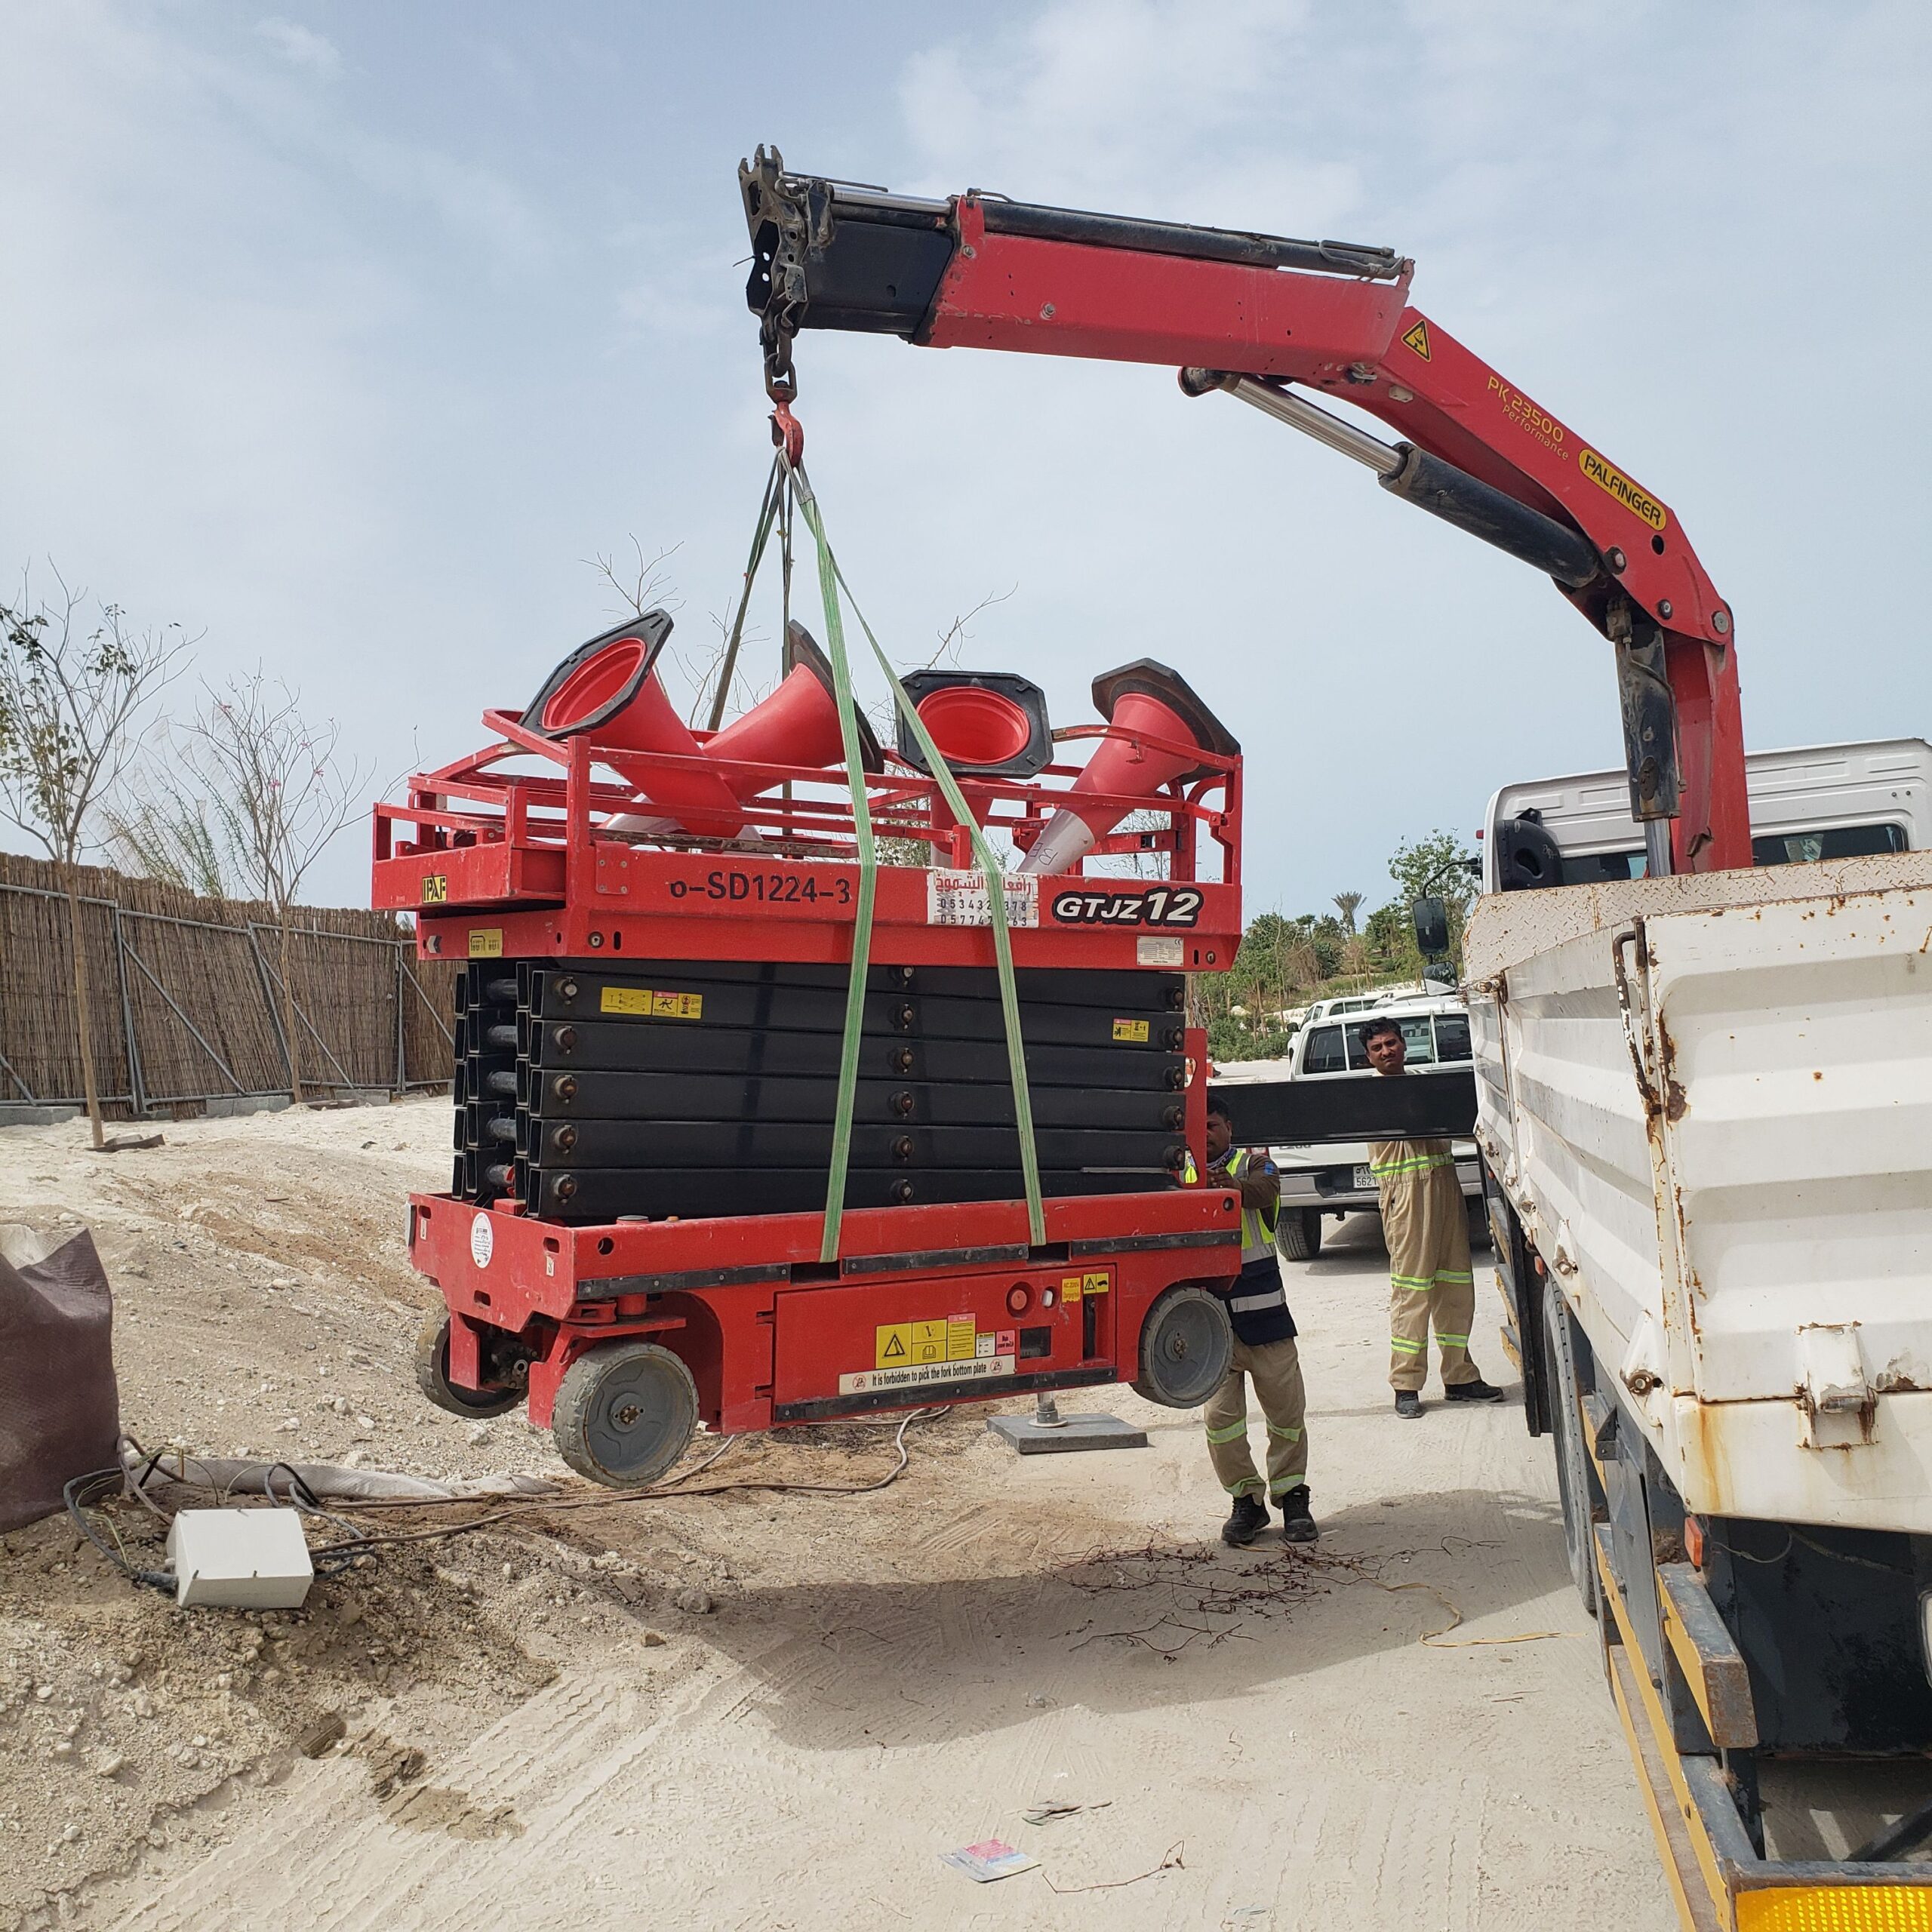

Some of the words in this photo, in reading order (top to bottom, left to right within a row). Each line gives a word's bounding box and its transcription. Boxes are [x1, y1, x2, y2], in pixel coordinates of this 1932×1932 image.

[1487, 376, 1509, 402] PK
[1511, 394, 1564, 443] 23500
[1502, 405, 1568, 460] Performance
[1584, 454, 1661, 525] PALFINGER
[423, 872, 446, 901] IPAF
[1003, 876, 1031, 896] رافعا
[940, 899, 1027, 911] 053432378
[872, 1374, 877, 1386] It
[878, 1374, 883, 1386] is
[884, 1370, 911, 1384] forbidden
[911, 1371, 917, 1381] to
[918, 1366, 930, 1383] pick
[931, 1366, 940, 1379] the
[940, 1364, 952, 1378] fork
[952, 1363, 973, 1377] bottom
[973, 1361, 986, 1377] plate
